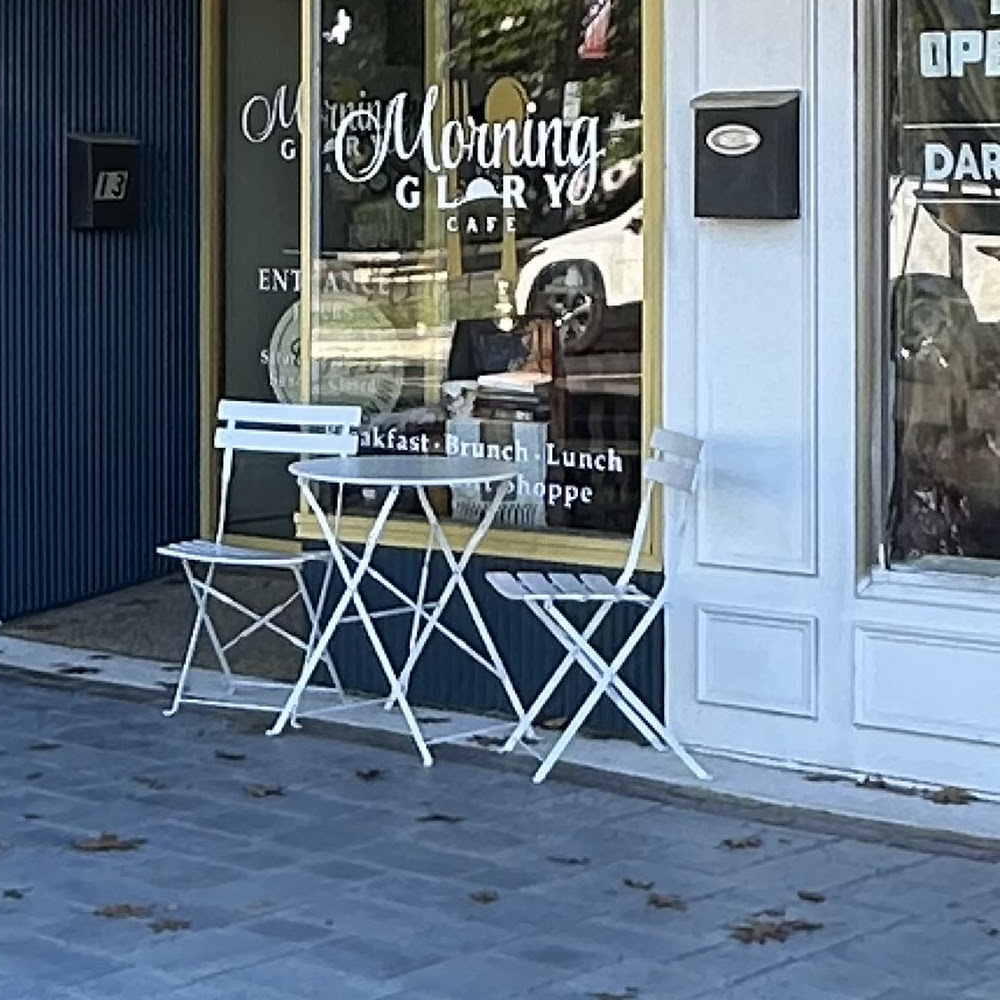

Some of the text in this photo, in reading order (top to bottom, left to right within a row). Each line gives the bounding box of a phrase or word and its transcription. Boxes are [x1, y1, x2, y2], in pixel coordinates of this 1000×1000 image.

[334, 85, 606, 206] Morning
[923, 142, 1000, 181] DAR
[94, 169, 129, 200] 13
[446, 215, 517, 233] CAFE
[445, 433, 529, 463] Brunch
[545, 442, 623, 473] Lunch
